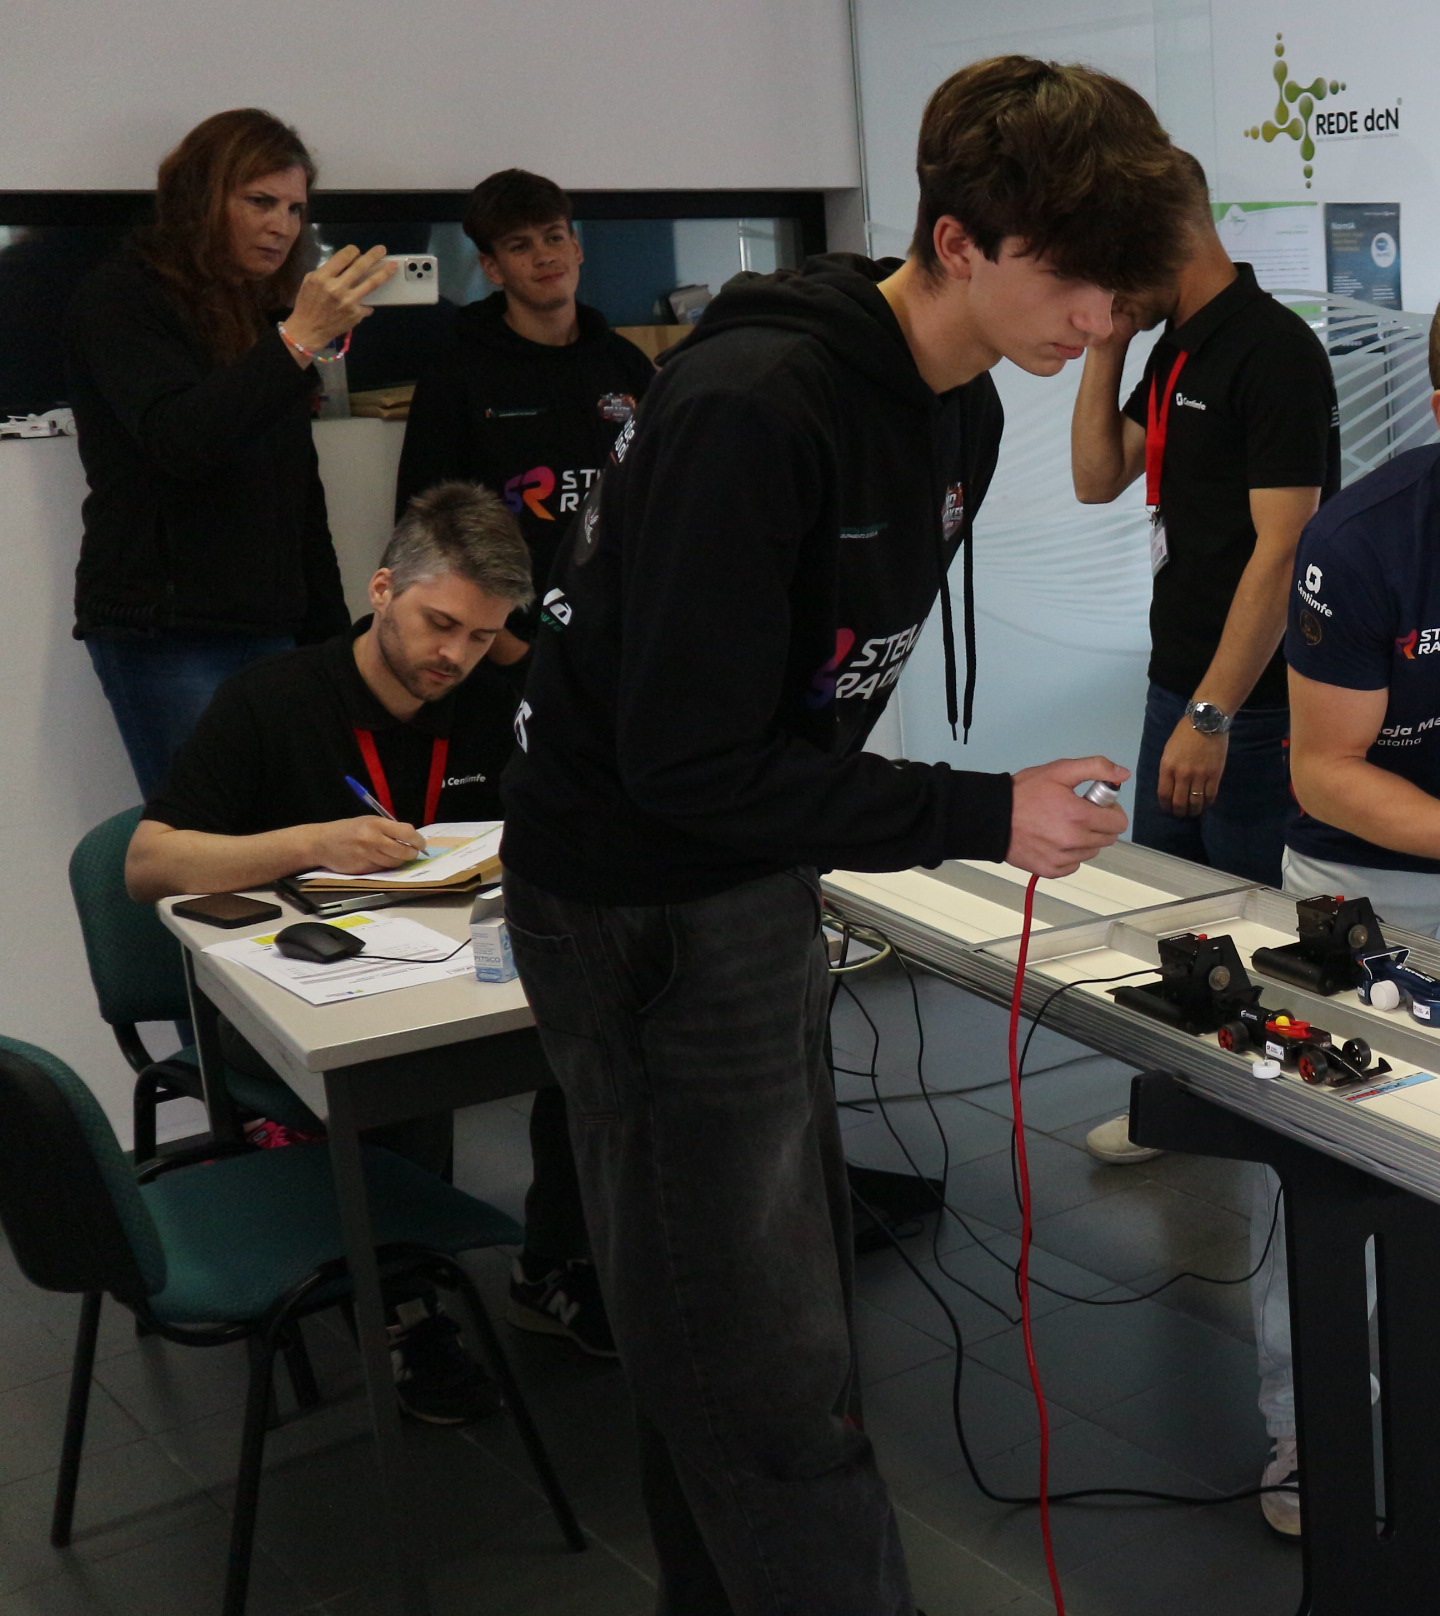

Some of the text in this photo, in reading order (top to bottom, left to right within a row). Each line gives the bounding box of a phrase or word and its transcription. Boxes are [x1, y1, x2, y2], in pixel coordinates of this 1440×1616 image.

[1316, 107, 1399, 135] REDE dcN
[1379, 725, 1413, 737] oja
[1374, 738, 1422, 747] atalha
